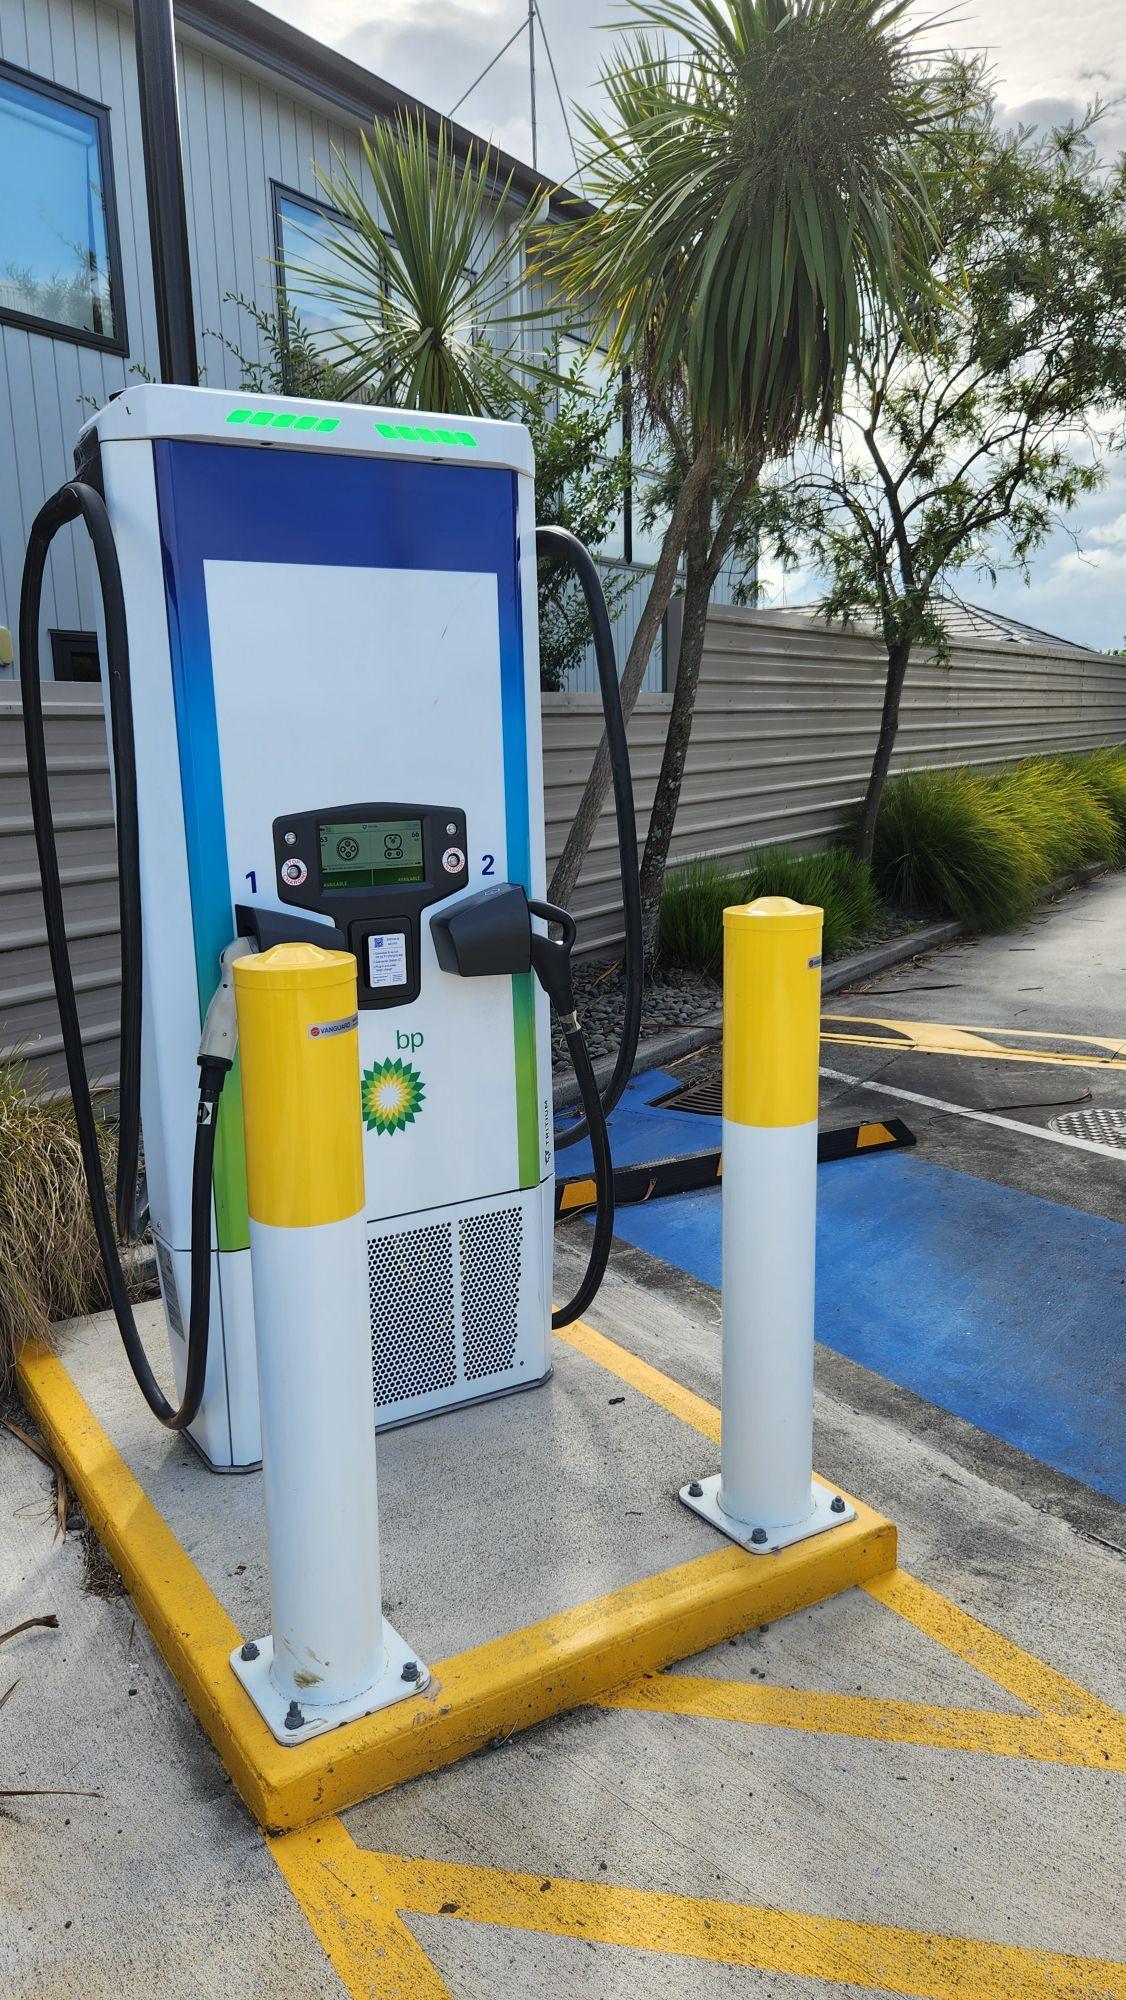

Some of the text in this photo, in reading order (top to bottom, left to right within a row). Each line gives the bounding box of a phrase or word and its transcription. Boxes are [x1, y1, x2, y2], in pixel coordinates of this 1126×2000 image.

[284, 859, 301, 868] STOP
[482, 855, 494, 875] 2
[246, 871, 257, 894] 1
[282, 870, 307, 886] CHARGING
[320, 1022, 351, 1033] VANGUARD
[397, 1030, 424, 1052] bp
